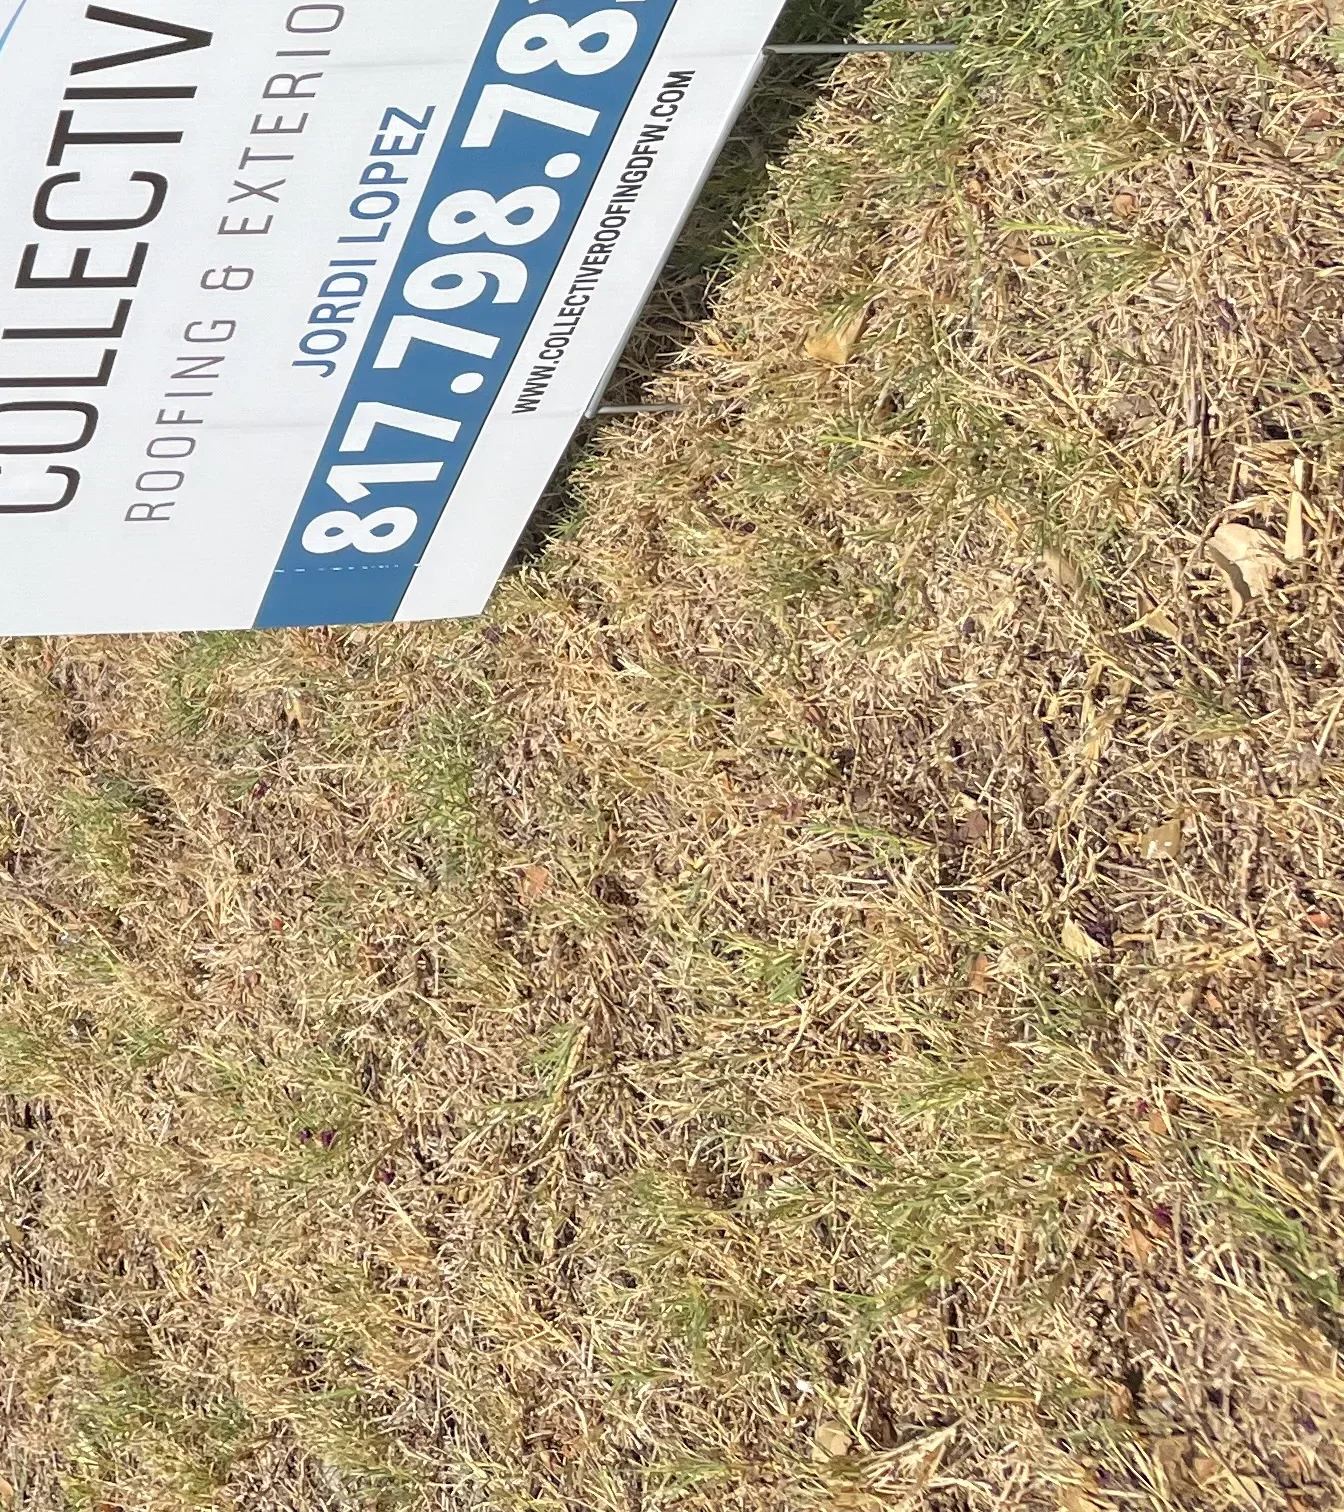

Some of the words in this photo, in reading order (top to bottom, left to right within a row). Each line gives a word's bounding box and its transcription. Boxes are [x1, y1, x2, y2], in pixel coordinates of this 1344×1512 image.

[291, 258, 369, 378] JORDI
[337, 105, 436, 243] LOPEZ
[512, 69, 696, 414] WWW.COLLECTIVEROOFINGDFW.COM
[124, 319, 237, 522] ROOFING
[200, 266, 254, 291] &
